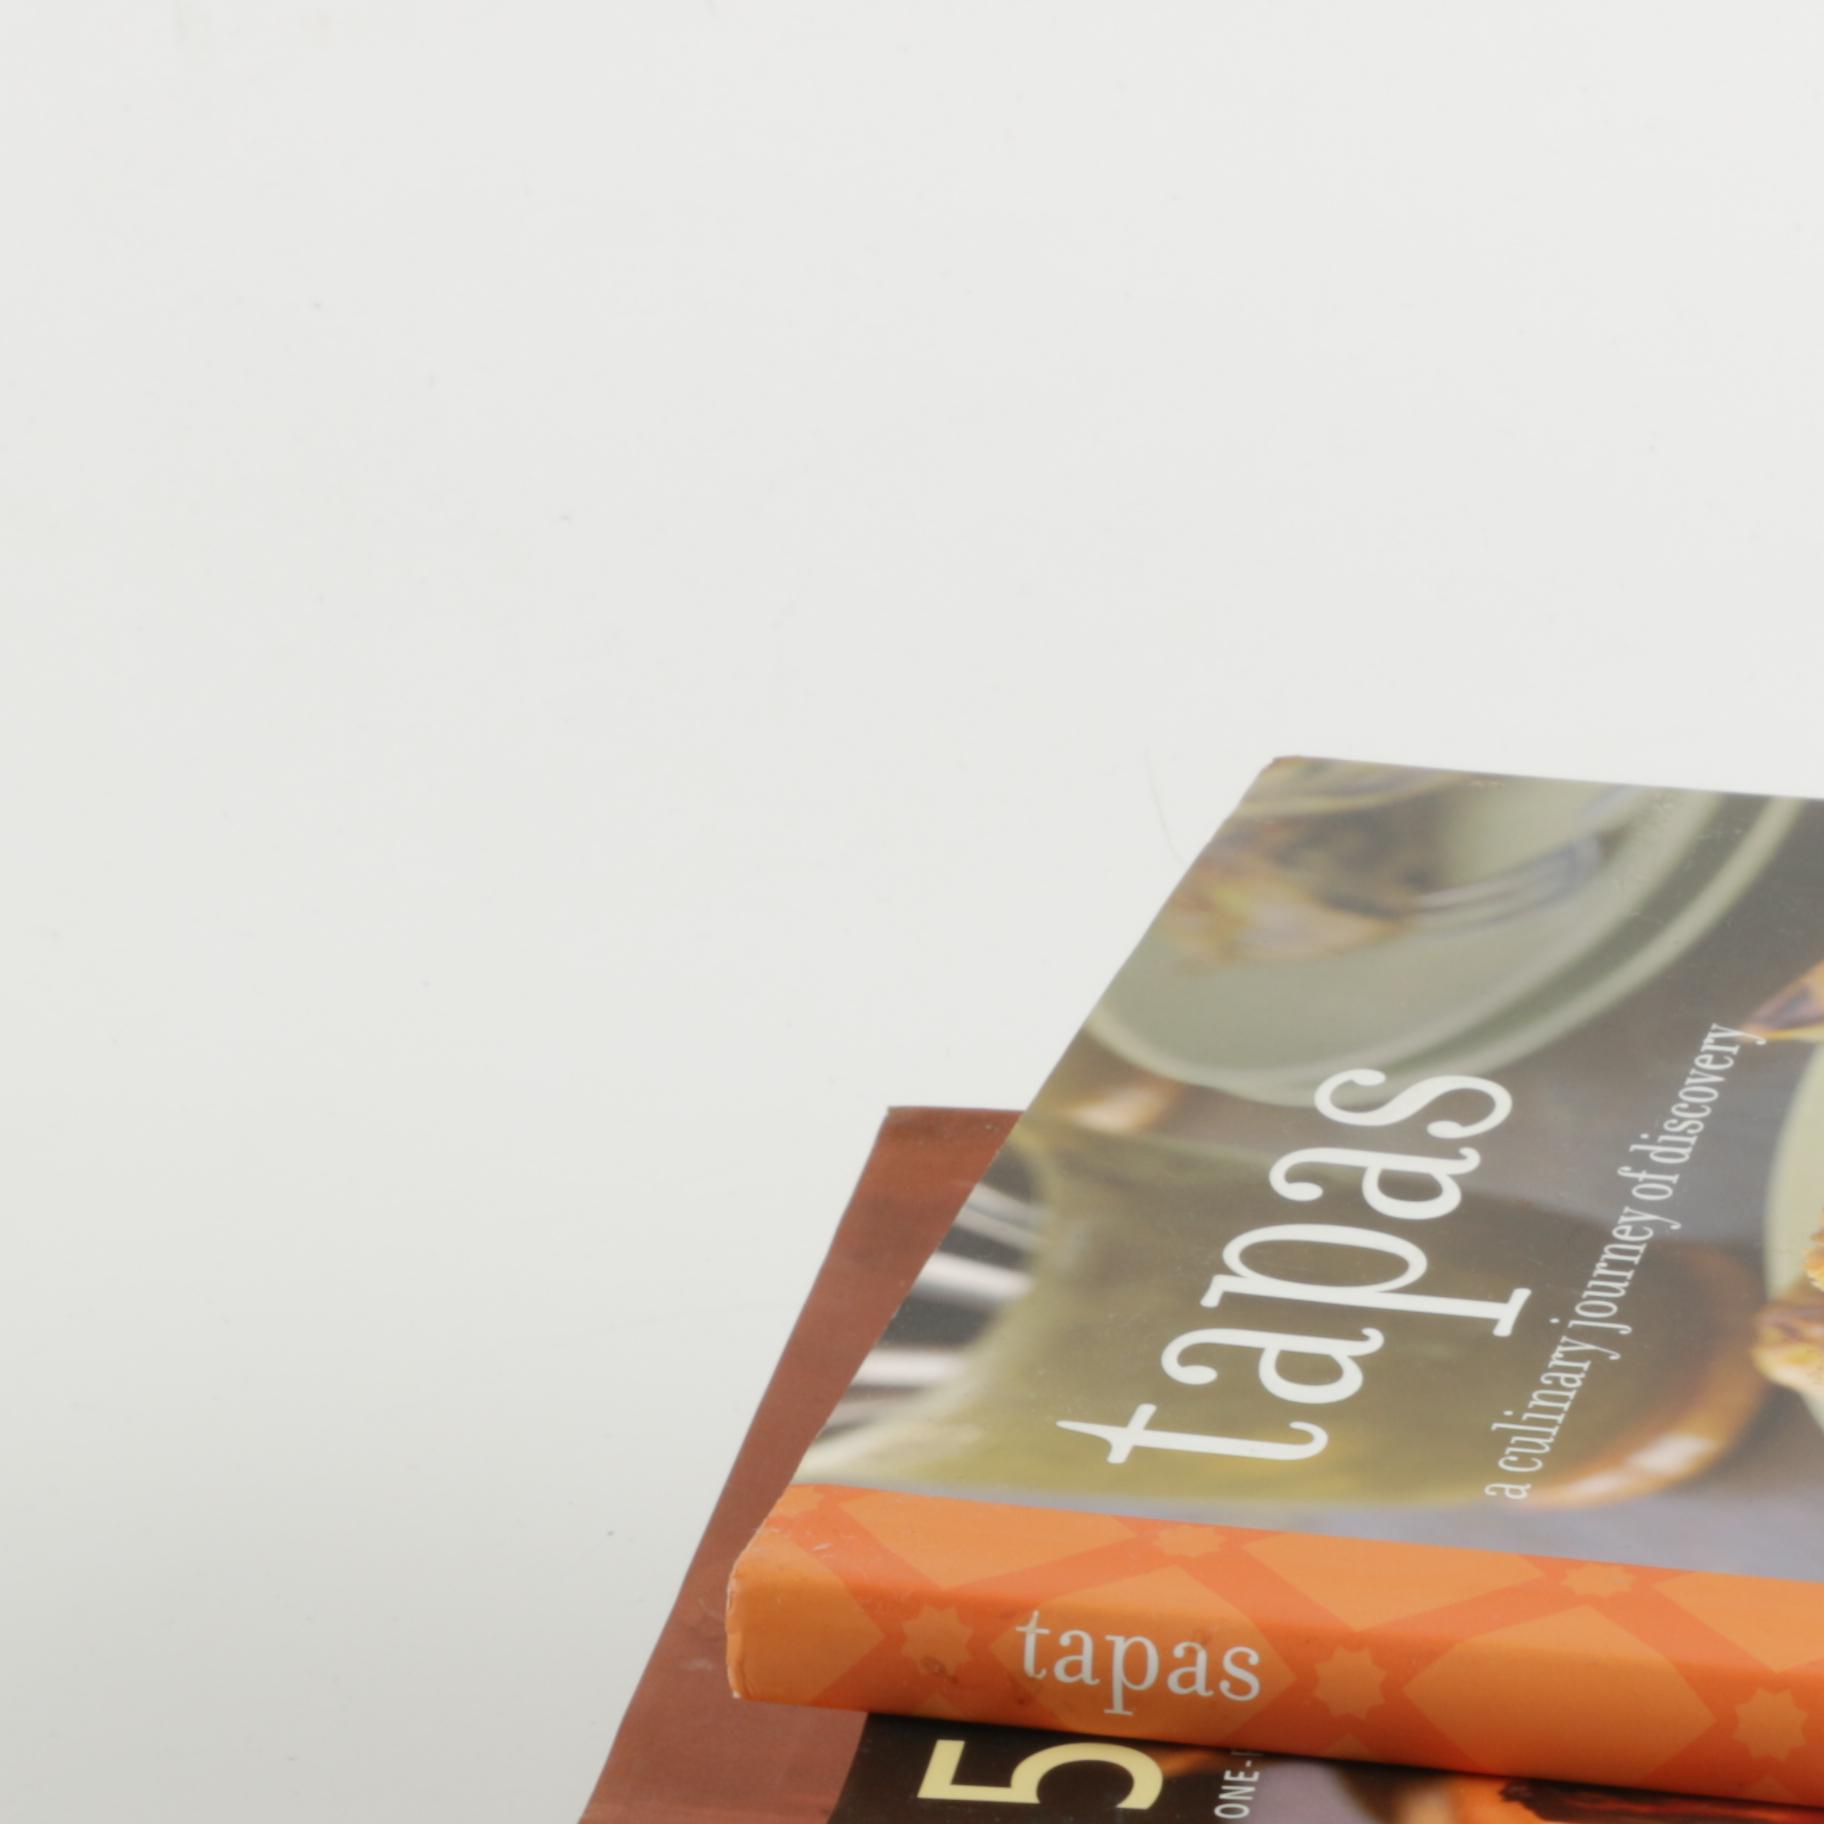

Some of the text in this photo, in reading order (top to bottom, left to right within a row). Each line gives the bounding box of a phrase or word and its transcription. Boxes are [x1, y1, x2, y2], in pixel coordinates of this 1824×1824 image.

[1056, 1068, 1531, 1464] tapas
[1484, 1022, 1767, 1500] a culinary journey of discovery
[1015, 1609, 1261, 1717] tapas
[1213, 1751, 1263, 1819] ONE-
